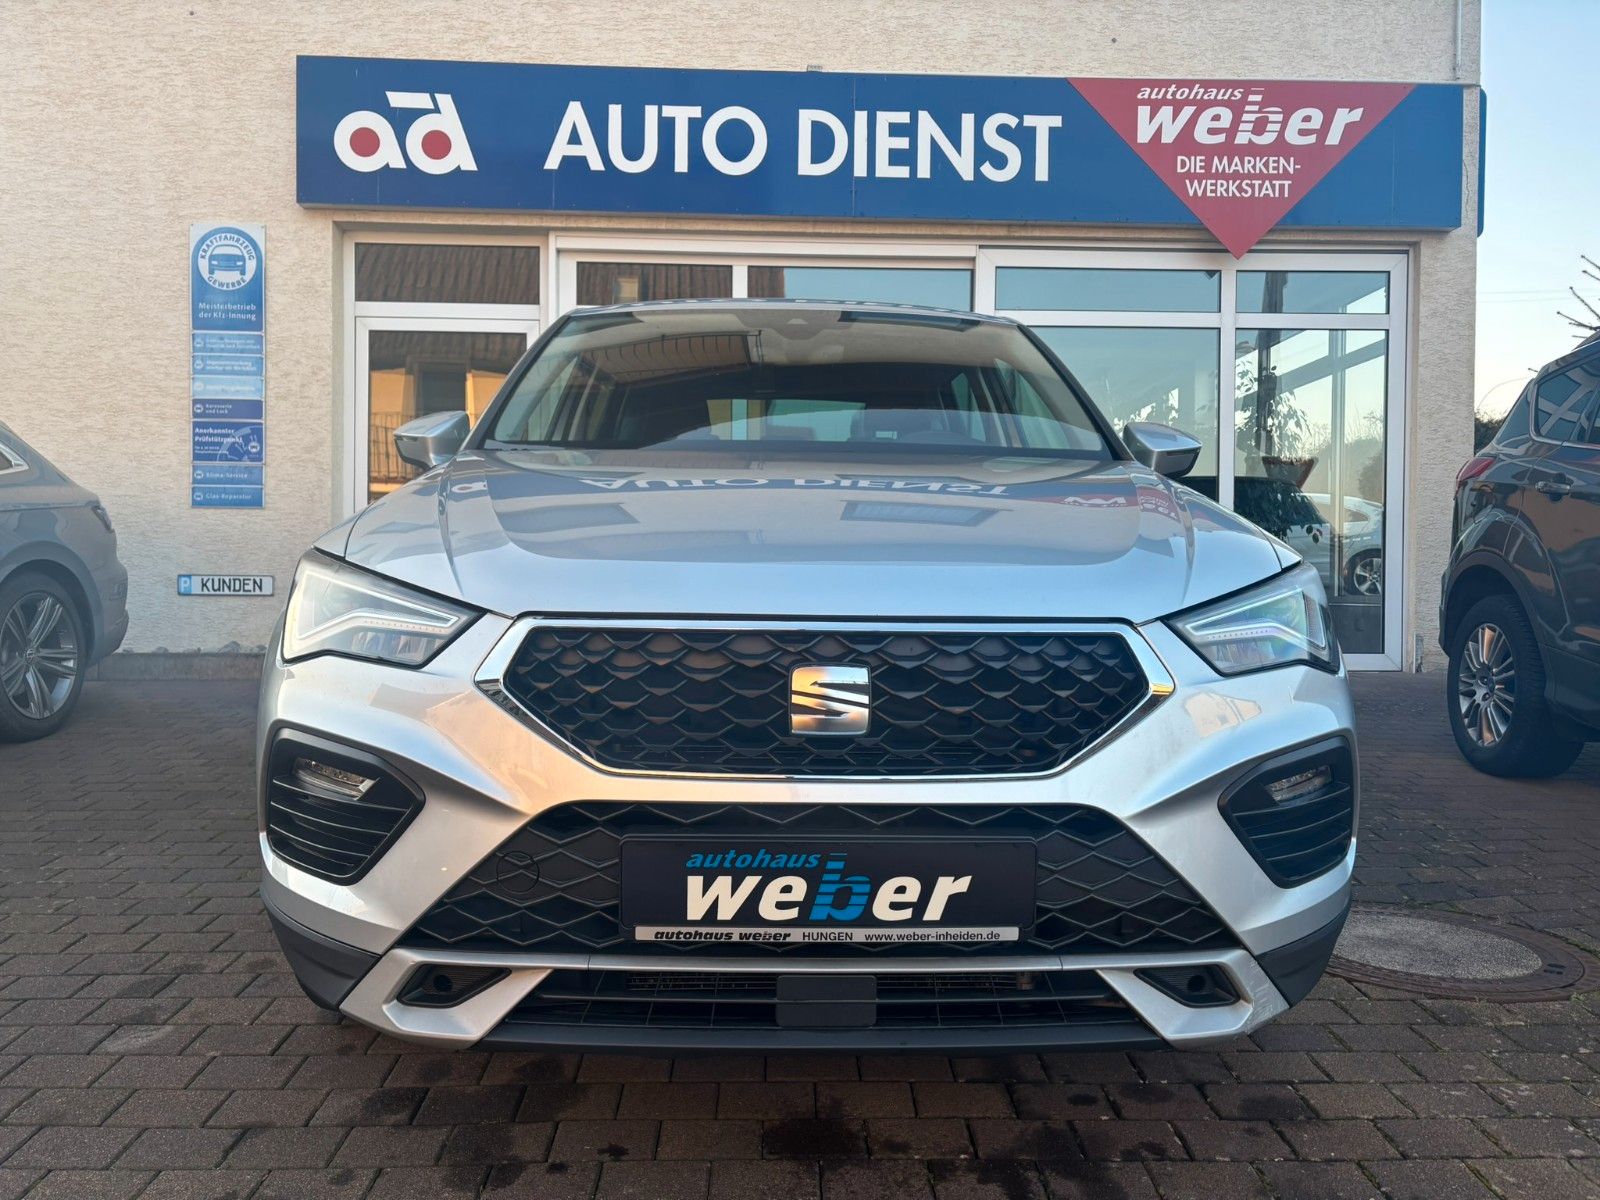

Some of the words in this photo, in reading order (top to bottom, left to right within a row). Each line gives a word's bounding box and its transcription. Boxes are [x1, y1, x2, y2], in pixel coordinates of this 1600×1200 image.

[1137, 84, 1244, 101] autohaus
[1137, 88, 1364, 146] weber
[544, 100, 768, 177] AUTO
[797, 108, 1062, 183] DIENST
[1176, 156, 1206, 174] DIE
[1211, 156, 1302, 175] MARKEN-
[1185, 179, 1292, 198] WERKSTATT
[200, 234, 255, 261] KRAFTFAHRZEUG
[207, 275, 247, 289] GEWERBE
[198, 302, 256, 310] Meisterbetrieb
[180, 577, 190, 590] P
[200, 577, 263, 593] KUNDEN
[686, 849, 821, 869] autohaus
[687, 853, 972, 922] weber
[654, 930, 734, 941] autohaus
[738, 930, 791, 941] weber
[802, 931, 853, 941] HUNGEN
[864, 930, 1000, 942] www.weber-inheiden.de
